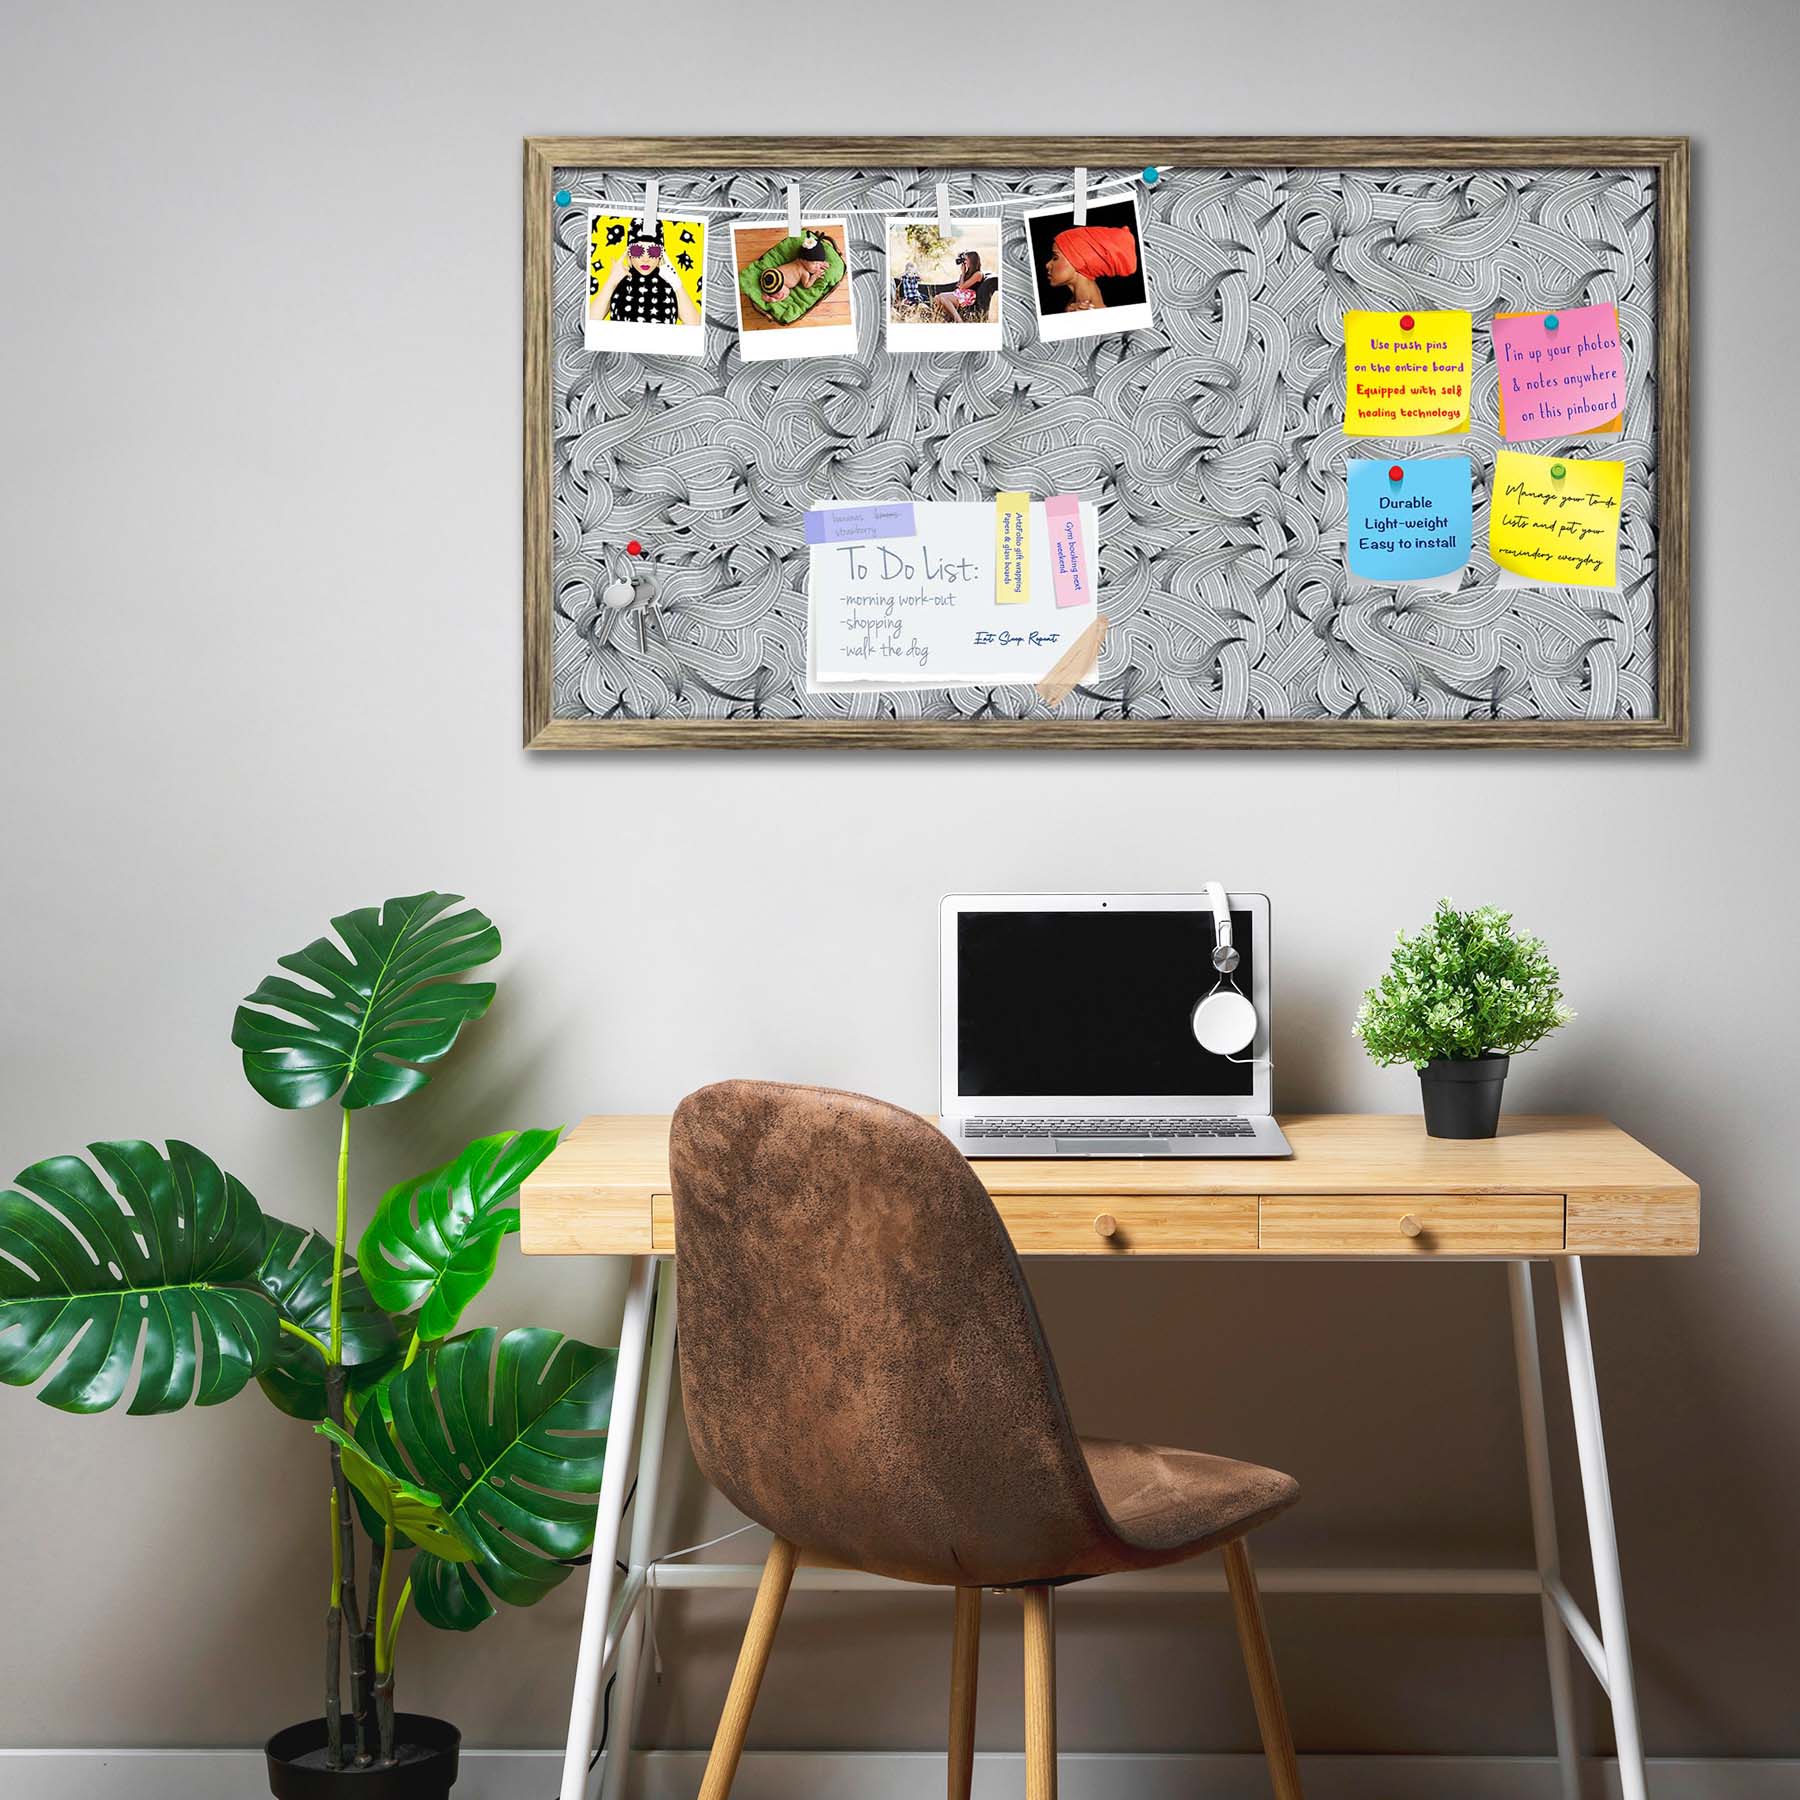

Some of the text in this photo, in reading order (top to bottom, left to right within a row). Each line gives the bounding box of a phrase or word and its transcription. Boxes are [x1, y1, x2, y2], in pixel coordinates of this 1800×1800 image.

[1371, 339, 1448, 353] Use push pins
[1504, 333, 1616, 363] Pin up your photos
[1371, 363, 1390, 373] the
[1395, 363, 1428, 372] entire
[1432, 361, 1464, 372] board
[1512, 365, 1617, 392] & notes anywhere
[1356, 384, 1462, 398] Equipped with self
[1358, 408, 1461, 420] healing technology
[1522, 393, 1617, 421] on this pinboard
[1379, 496, 1433, 509] Durable
[1505, 482, 1557, 505] Manage
[1561, 496, 1584, 508] your
[1003, 512, 1012, 535] Papers
[1365, 516, 1449, 532] Light-weight
[1532, 520, 1557, 532] and
[1559, 521, 1582, 537] put
[1582, 527, 1605, 540] your
[1003, 543, 1012, 560] glass
[1014, 548, 1024, 560] gift
[1359, 536, 1456, 552] Easy to install
[836, 545, 979, 583] To Do List:
[1057, 542, 1068, 574] weekend
[1065, 521, 1082, 591] Gym booking next
[1499, 548, 1604, 571] reminders everyday
[1004, 561, 1012, 584] boards
[1014, 561, 1022, 592] wrapping
[899, 586, 957, 606] work-out
[880, 635, 903, 656] the
[906, 638, 928, 666] dog
